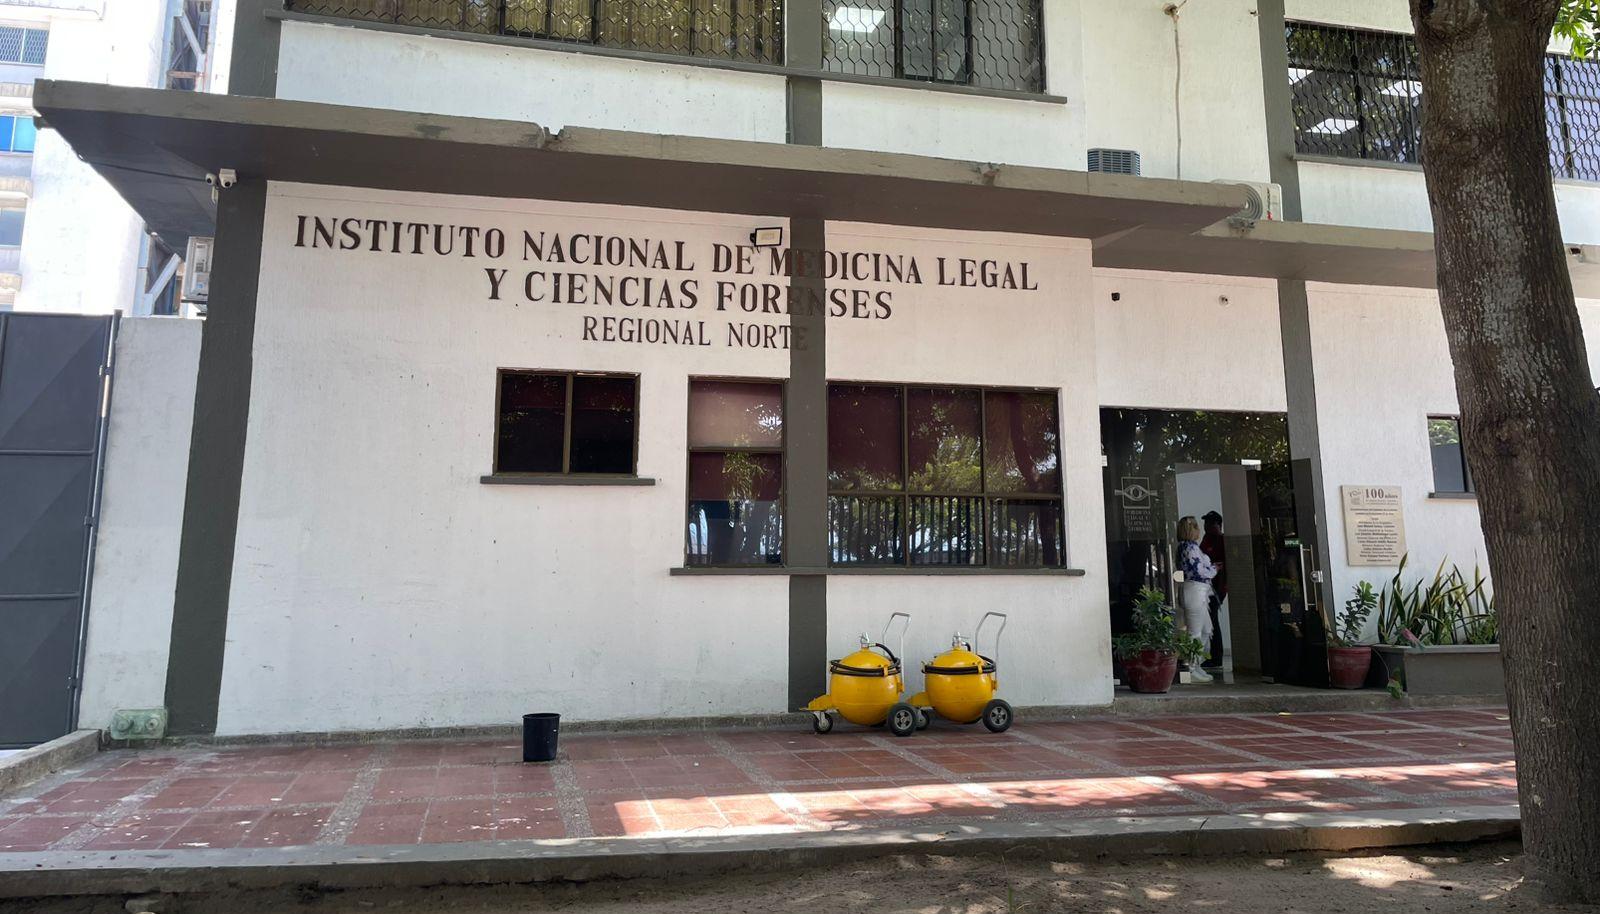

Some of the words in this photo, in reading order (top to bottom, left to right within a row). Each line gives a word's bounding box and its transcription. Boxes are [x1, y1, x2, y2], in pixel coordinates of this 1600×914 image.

[294, 215, 505, 258] INSTITUTO
[523, 230, 695, 271] NACIONAL
[712, 243, 754, 275] DE
[770, 247, 922, 284] MEDICINA
[937, 257, 1038, 290] LEGAL
[485, 268, 508, 300] Y
[525, 270, 698, 309] CIENCIAS
[717, 281, 892, 319] FORENSES
[583, 316, 711, 346] REGIONAL
[1366, 488, 1384, 498] 100
